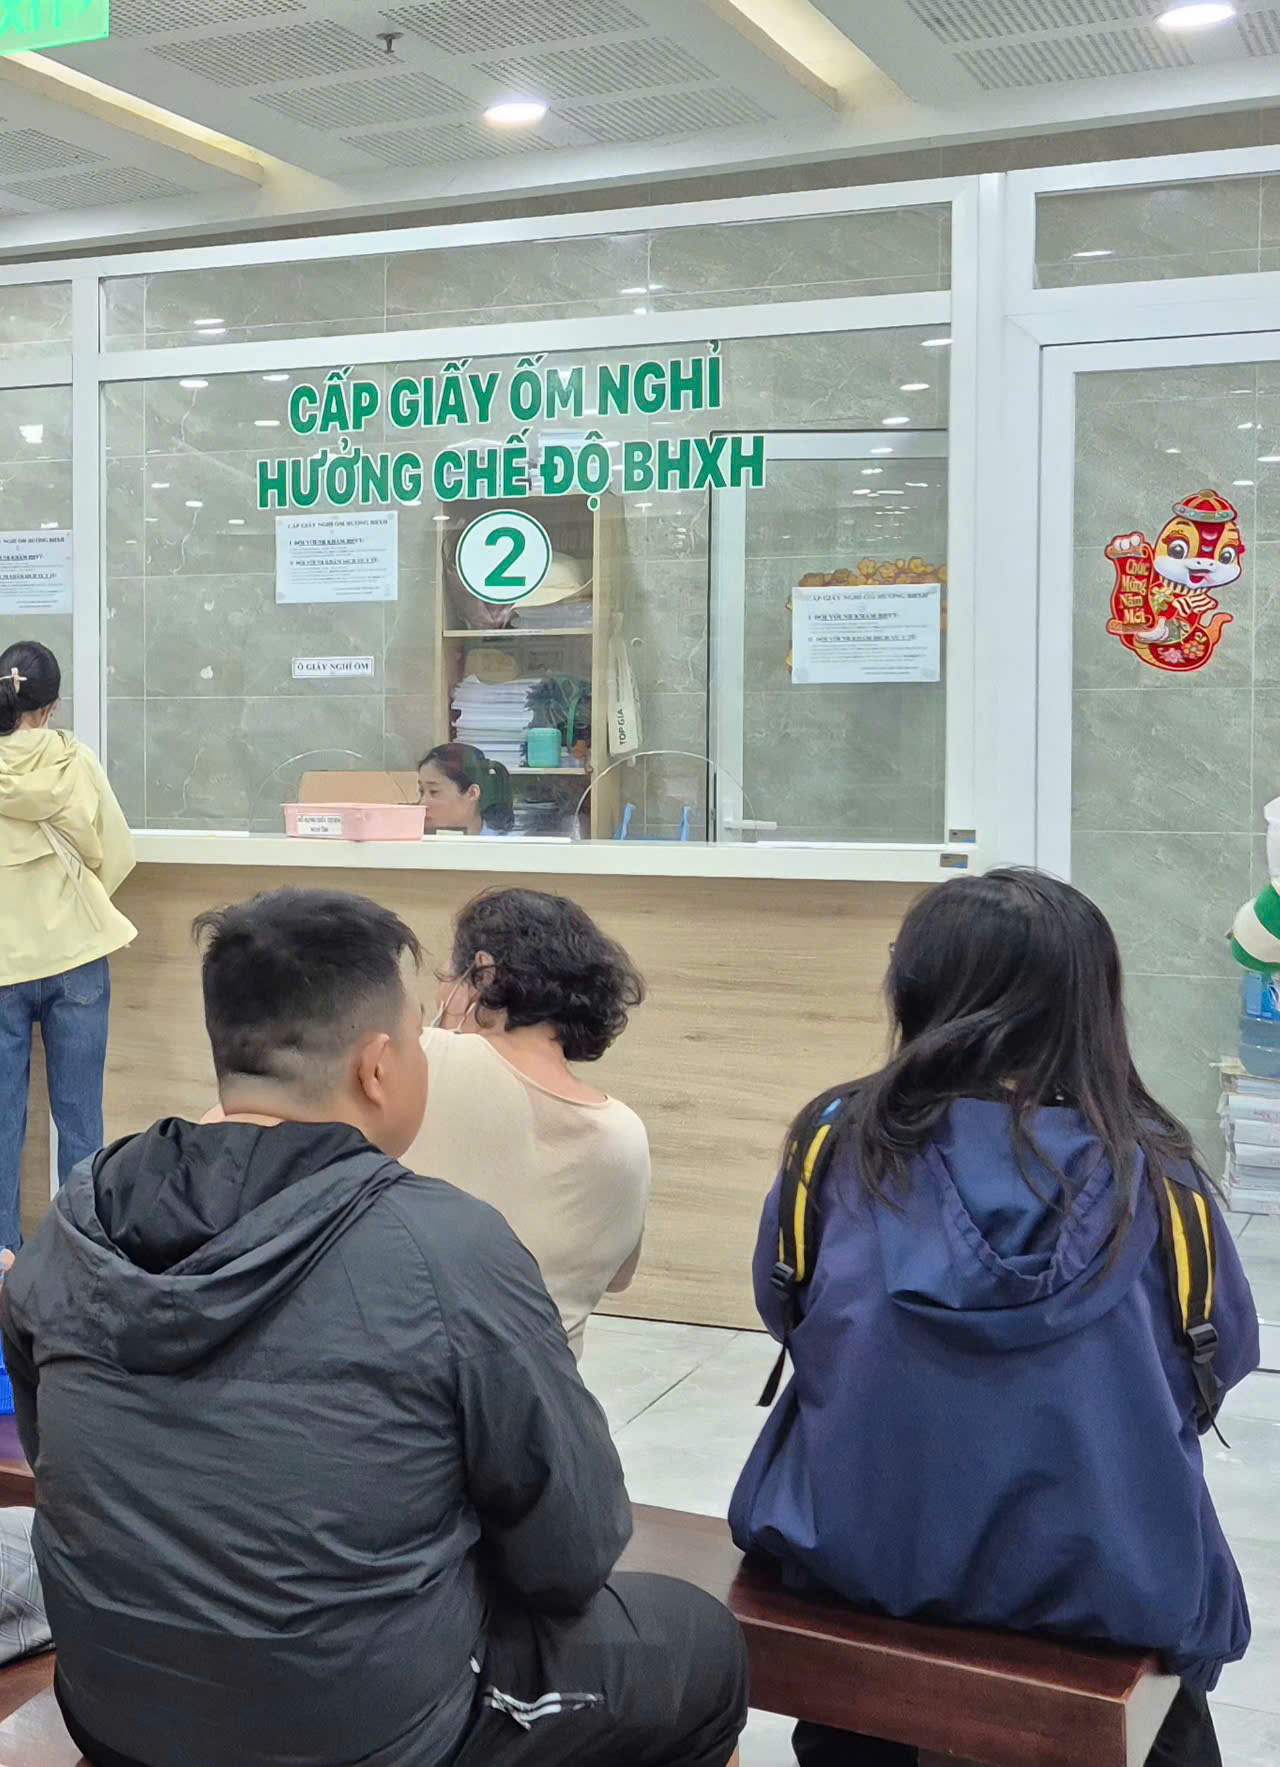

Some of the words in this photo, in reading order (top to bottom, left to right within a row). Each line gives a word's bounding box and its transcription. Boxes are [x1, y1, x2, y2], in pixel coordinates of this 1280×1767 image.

[290, 365, 378, 434] CẤP
[390, 358, 501, 430] GIẤY
[510, 353, 583, 422] ỐM
[598, 339, 722, 417] NGHỈ
[257, 437, 422, 509] HƯỞNG
[433, 428, 531, 500] CHẾ
[540, 430, 610, 511] ĐỘ
[624, 435, 765, 492] BHXH
[483, 526, 527, 587] 2
[616, 708, 625, 726] GIA
[618, 727, 627, 745] TOP
